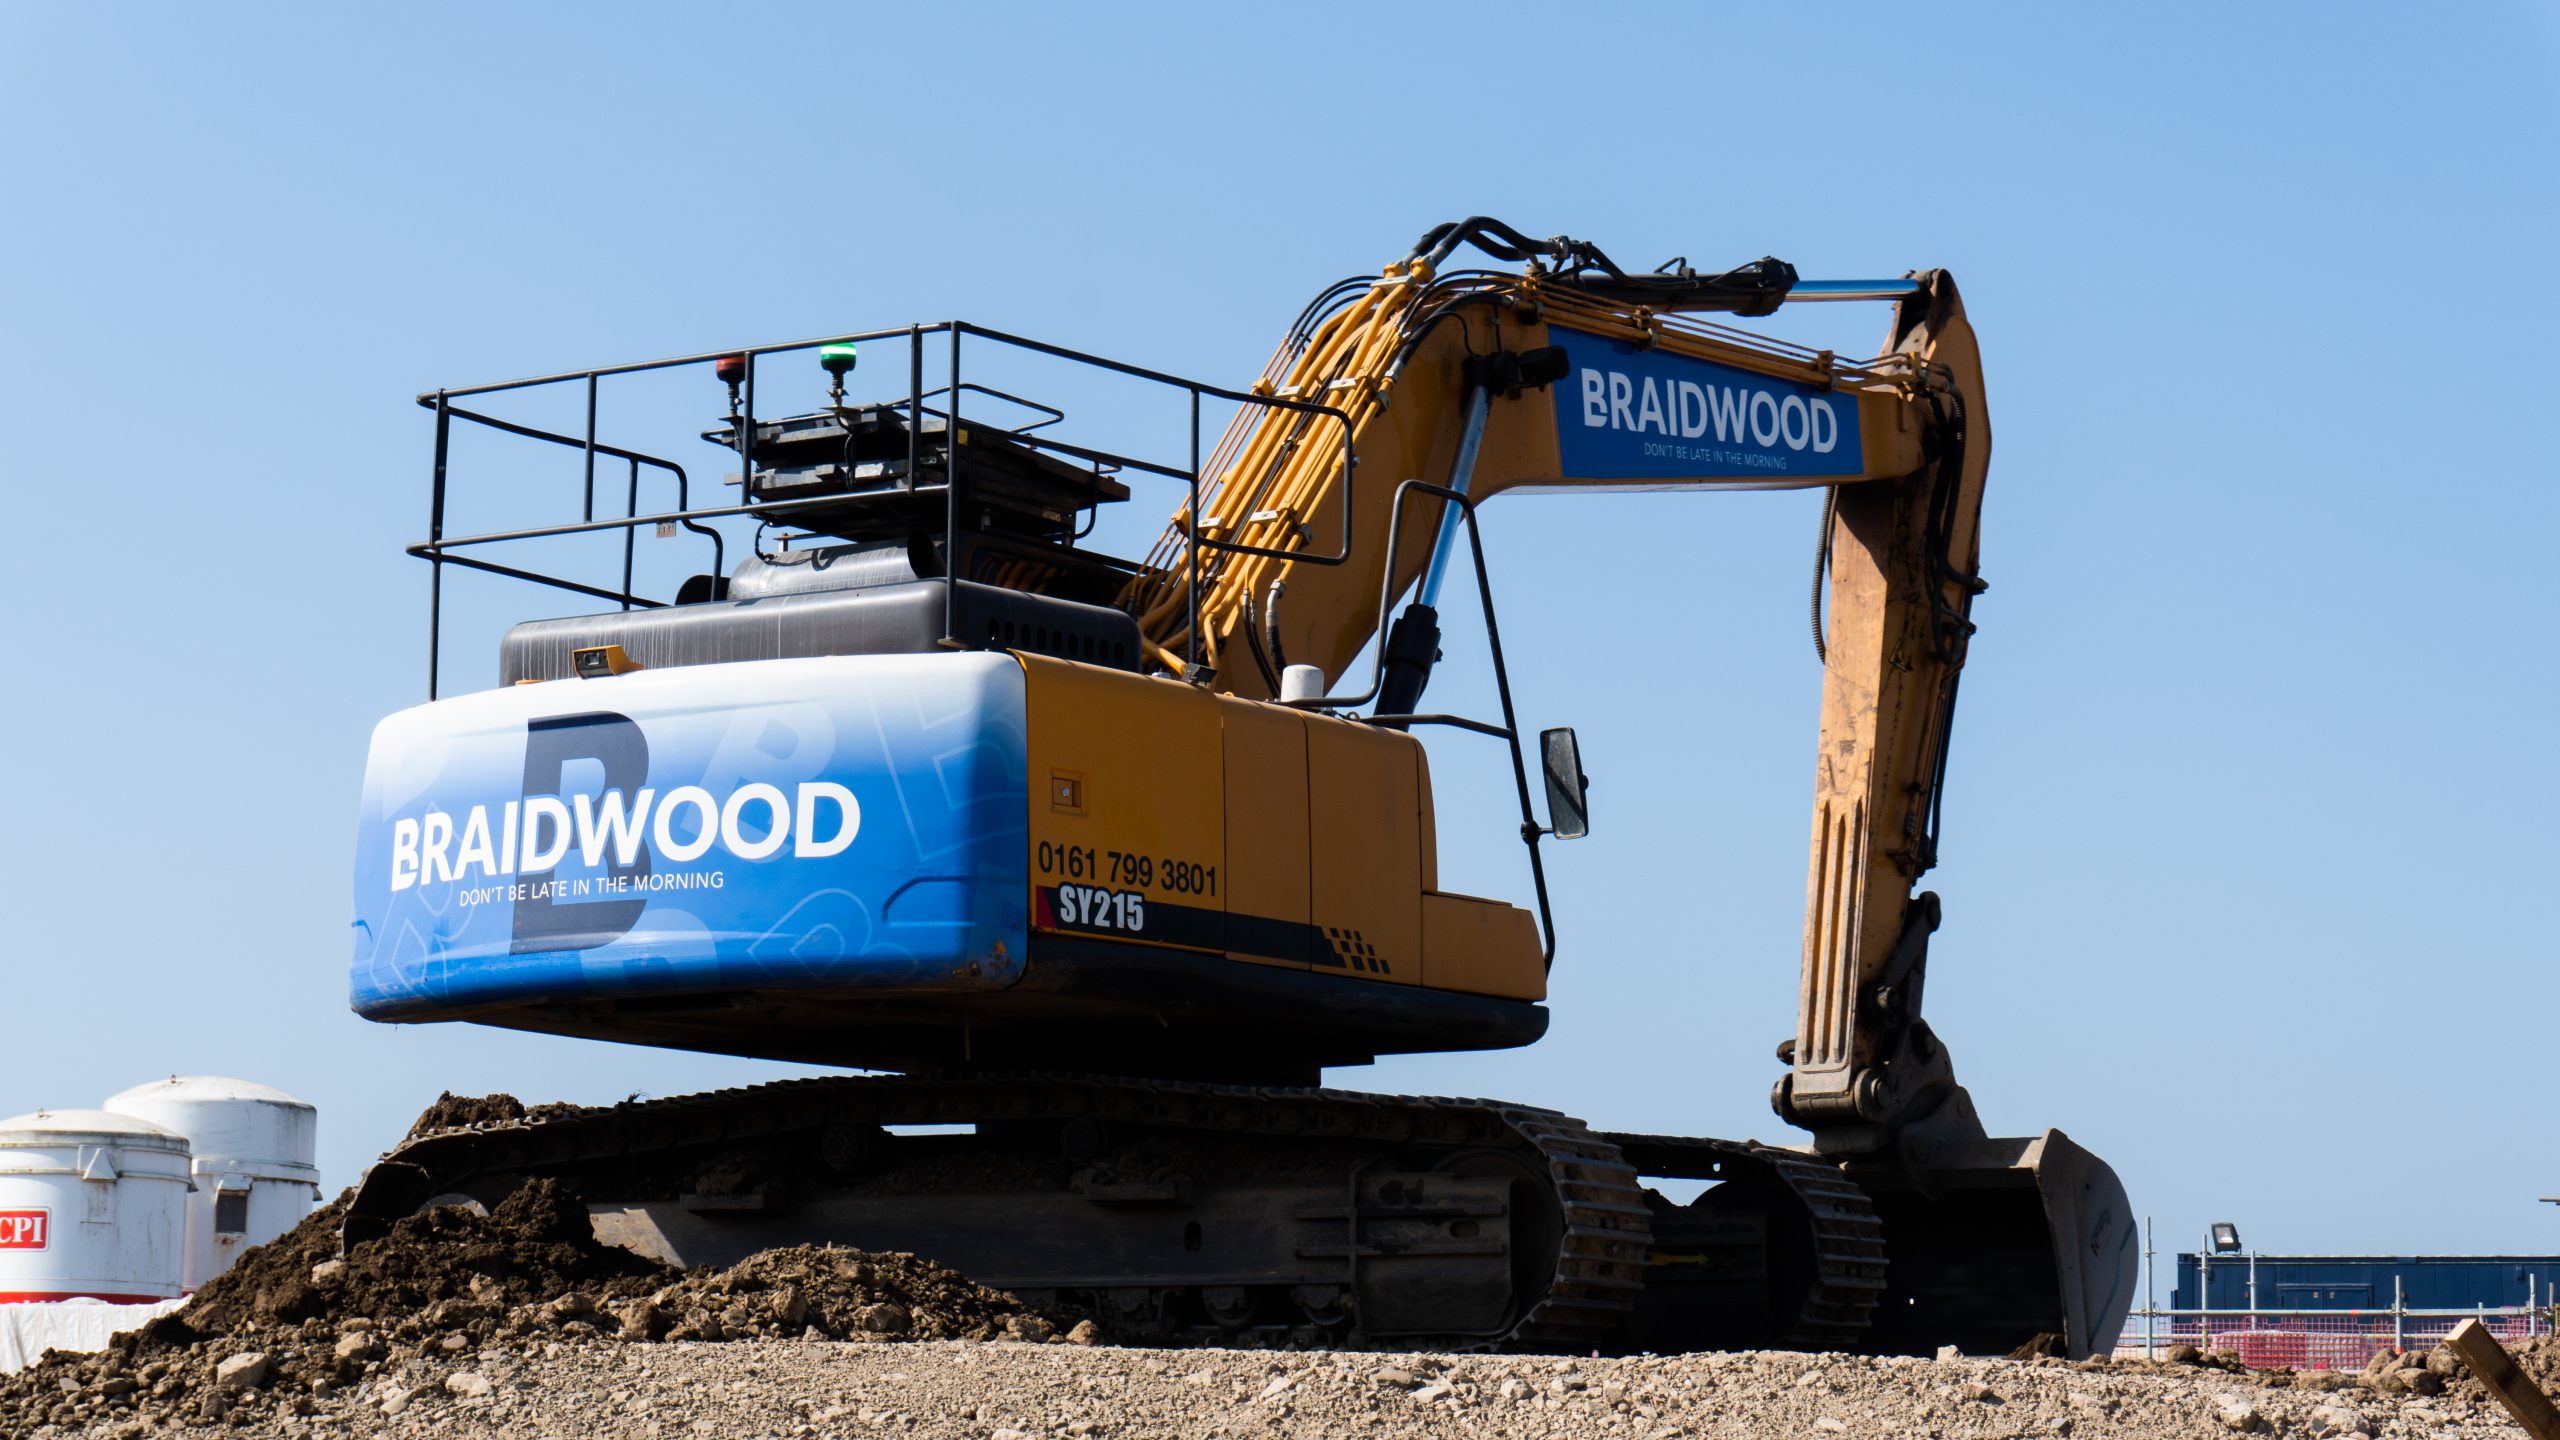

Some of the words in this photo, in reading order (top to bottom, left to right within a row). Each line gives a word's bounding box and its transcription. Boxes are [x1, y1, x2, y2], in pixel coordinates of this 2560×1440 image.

[1581, 368, 1837, 453] BRAIDWOOD
[1644, 443, 1673, 457] DON'T
[1676, 446, 1688, 459] BE
[1690, 448, 1711, 462] LATE
[1713, 450, 1723, 463] IN
[1725, 451, 1742, 465] THE
[1744, 454, 1787, 470] MORNING
[391, 782, 861, 892] BRAIDWOOD
[459, 886, 504, 907] DON'T
[508, 884, 527, 902] BE
[531, 880, 567, 899] LATE
[572, 879, 590, 896] IN
[595, 876, 628, 894] THE
[634, 871, 724, 892] MORNING
[1038, 841, 1095, 880] 0161
[1107, 851, 1153, 888] 799
[1160, 859, 1216, 897] 3801
[1059, 885, 1144, 932] SY215
[0, 1216, 45, 1243] CPI
